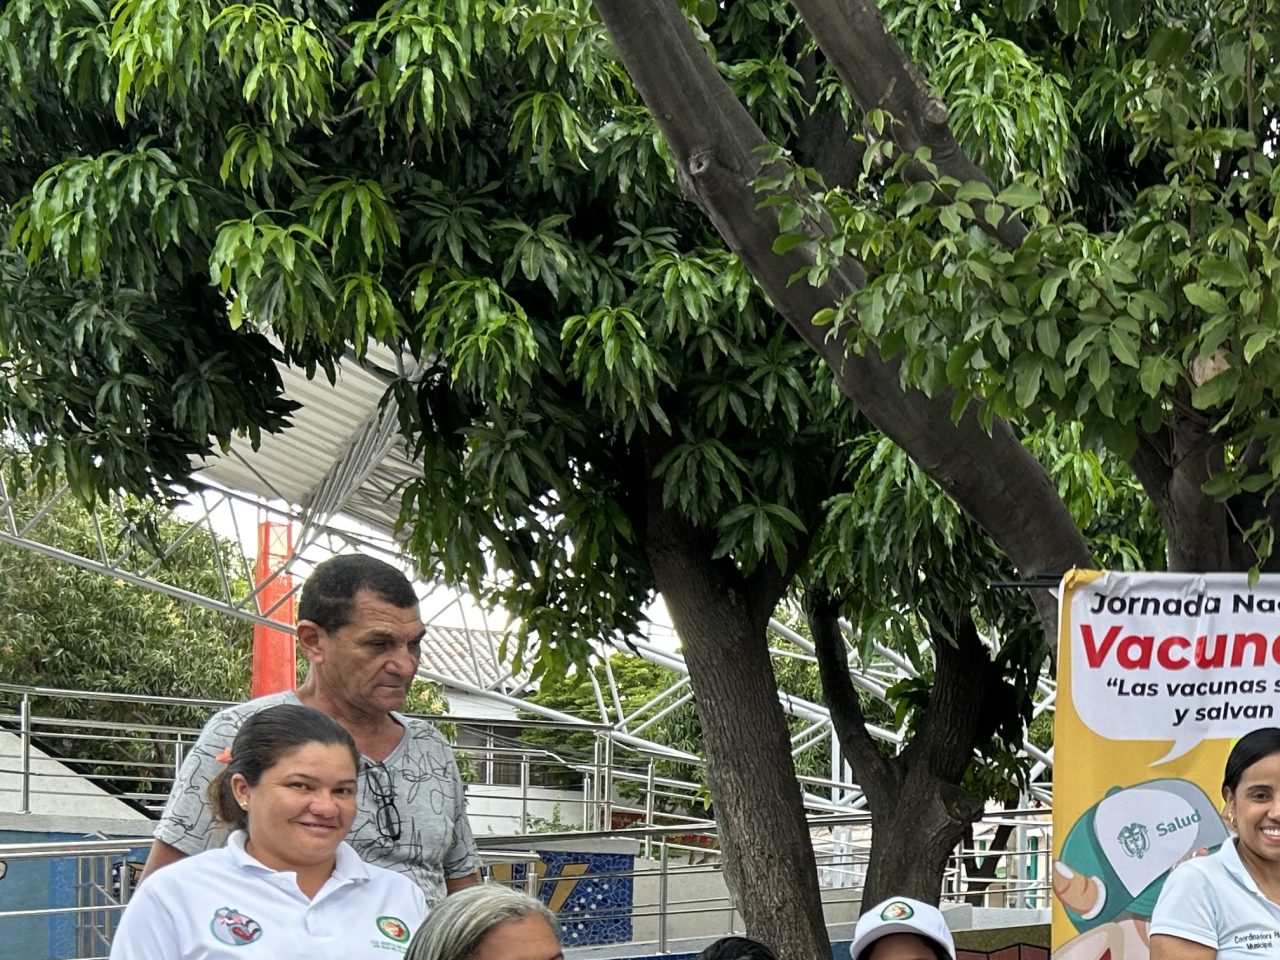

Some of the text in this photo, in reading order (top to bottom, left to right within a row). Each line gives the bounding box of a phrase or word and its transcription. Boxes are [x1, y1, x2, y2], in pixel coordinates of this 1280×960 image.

[1090, 592, 1221, 617] Jornada
[1166, 678, 1267, 697] vacunas
[1172, 707, 1190, 727] y
[1195, 701, 1274, 721] salvan
[1156, 808, 1202, 837] Salud
